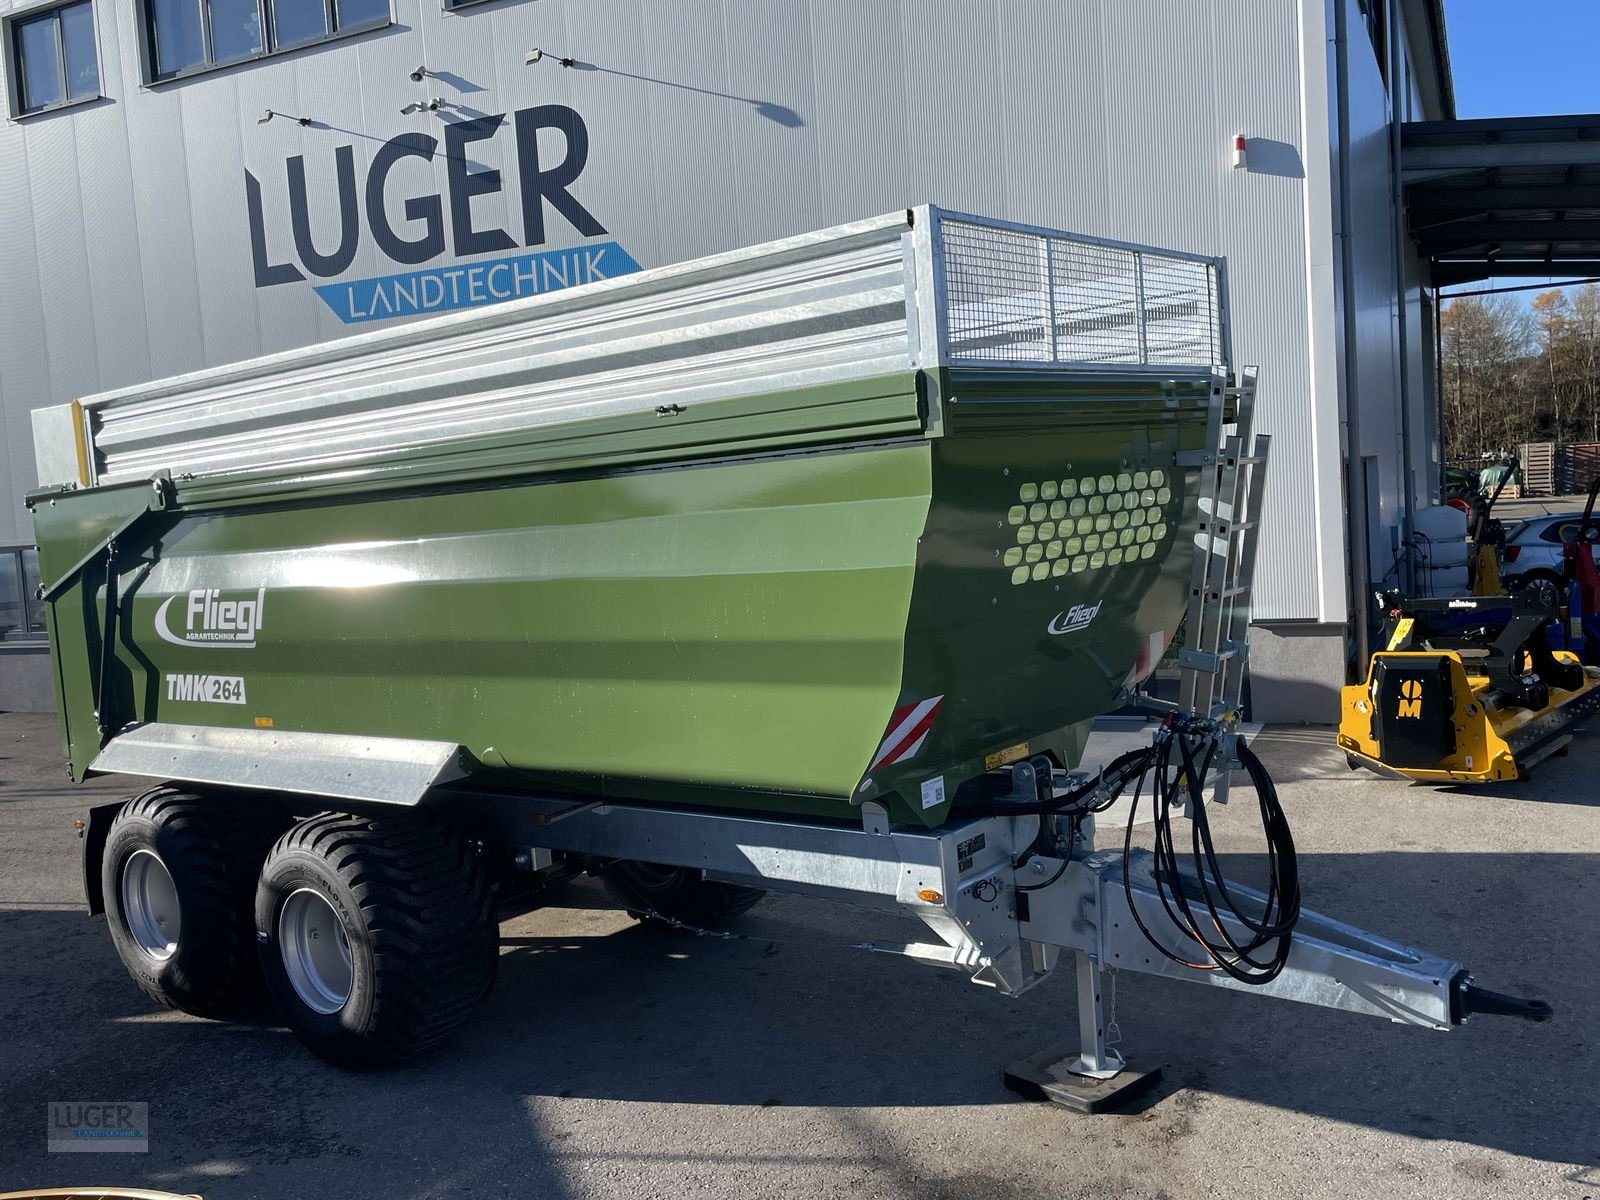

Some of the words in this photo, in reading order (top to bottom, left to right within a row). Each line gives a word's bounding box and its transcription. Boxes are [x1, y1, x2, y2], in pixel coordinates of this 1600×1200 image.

[245, 104, 608, 287] LUGER
[348, 249, 608, 318] LANDTECHNIK
[187, 588, 266, 640] Fliegl
[1063, 600, 1103, 625] Fliegl
[186, 633, 235, 641] AGRARTECHNIK
[166, 674, 208, 702] TMK
[212, 679, 242, 701] 264
